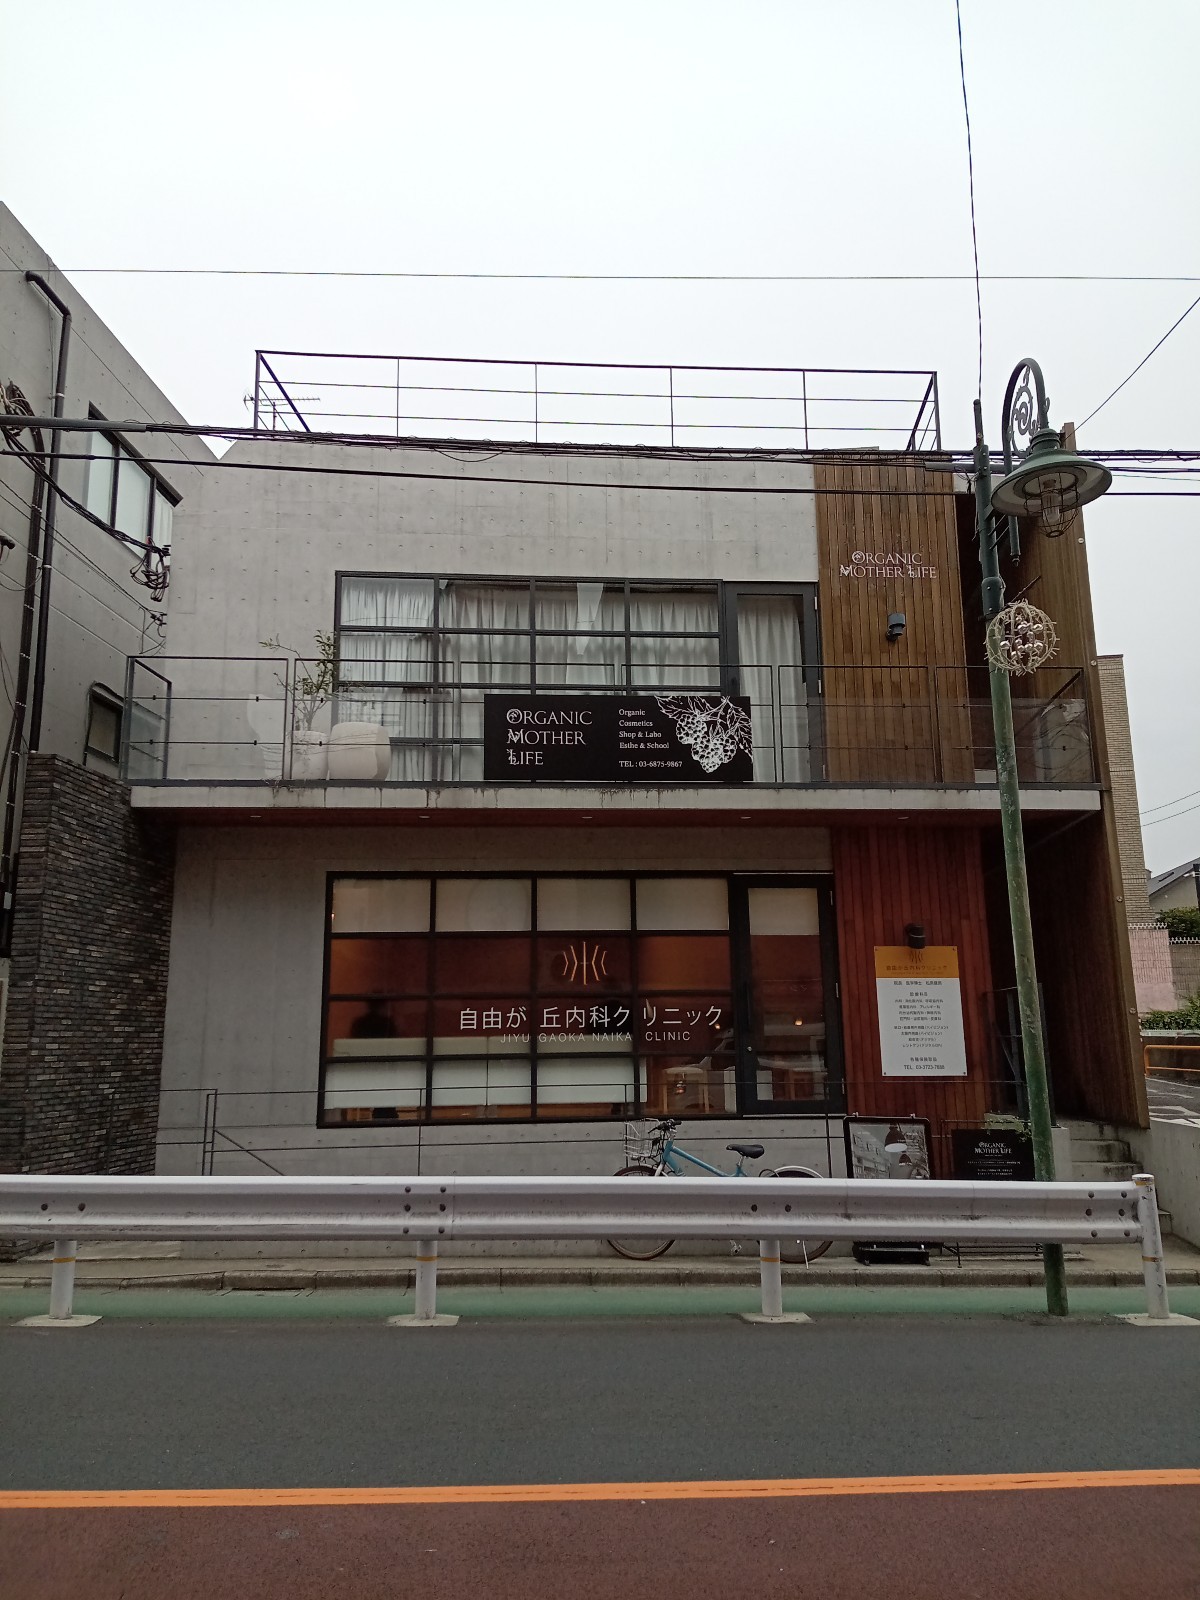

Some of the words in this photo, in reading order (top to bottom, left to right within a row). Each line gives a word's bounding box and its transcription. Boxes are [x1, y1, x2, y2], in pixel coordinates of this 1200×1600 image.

[852, 551, 923, 565] ORGANIC
[839, 564, 905, 578] MOTHER
[906, 564, 937, 579] LIFE
[506, 708, 593, 725] ORGANIC
[618, 708, 646, 718] Organic
[506, 728, 586, 745] MOTHER
[618, 731, 637, 739] Shop
[506, 748, 544, 766] LIFE
[638, 760, 683, 768] 03-6875-9867
[500, 1033, 531, 1043] JIYU
[538, 1032, 586, 1043] GAOKA
[592, 1032, 633, 1042] NAIKA
[645, 1031, 691, 1042] CLINIC
